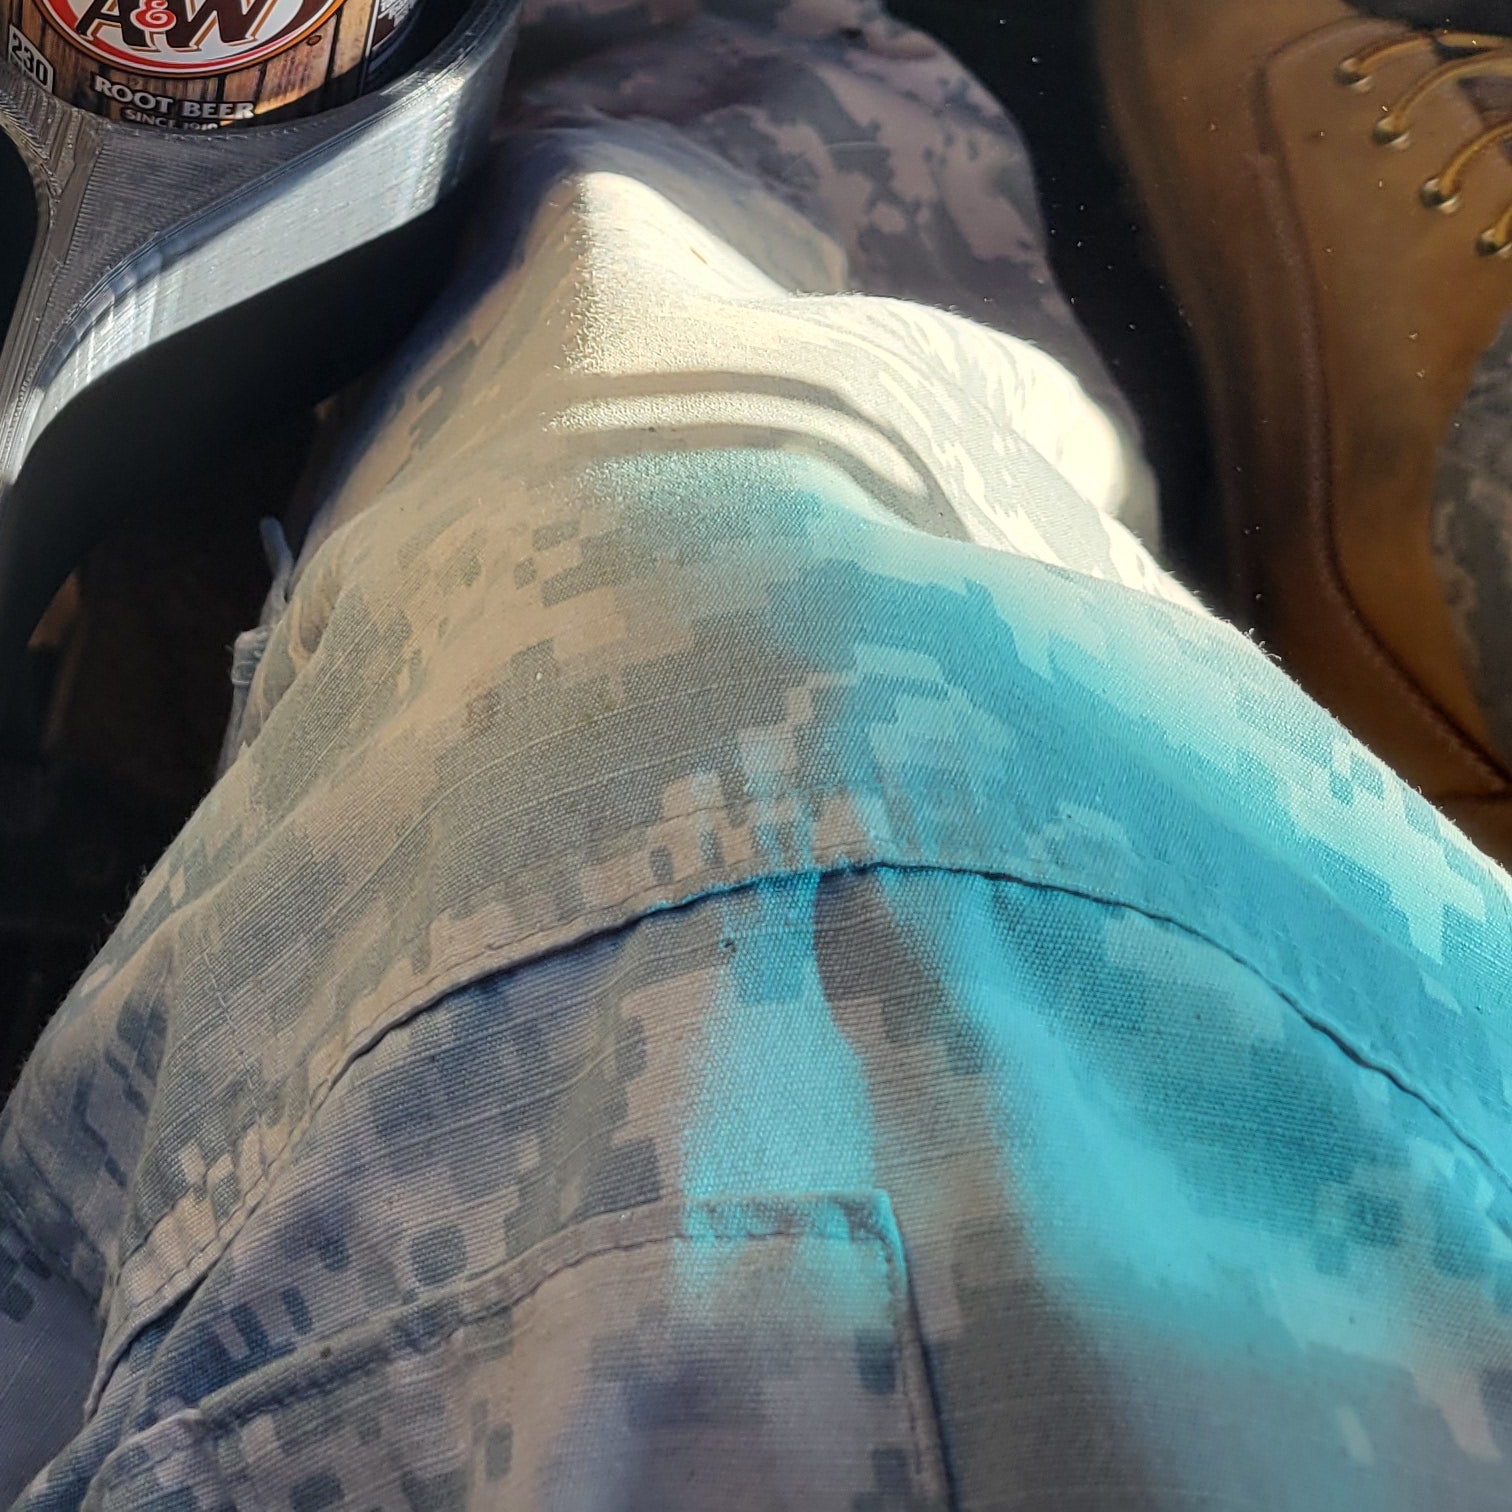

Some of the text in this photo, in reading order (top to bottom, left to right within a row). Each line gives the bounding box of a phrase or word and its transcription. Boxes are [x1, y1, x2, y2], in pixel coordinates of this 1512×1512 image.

[12, 34, 48, 86] 230
[93, 74, 256, 120] ROOT BEER
[124, 108, 177, 128] SINCE
